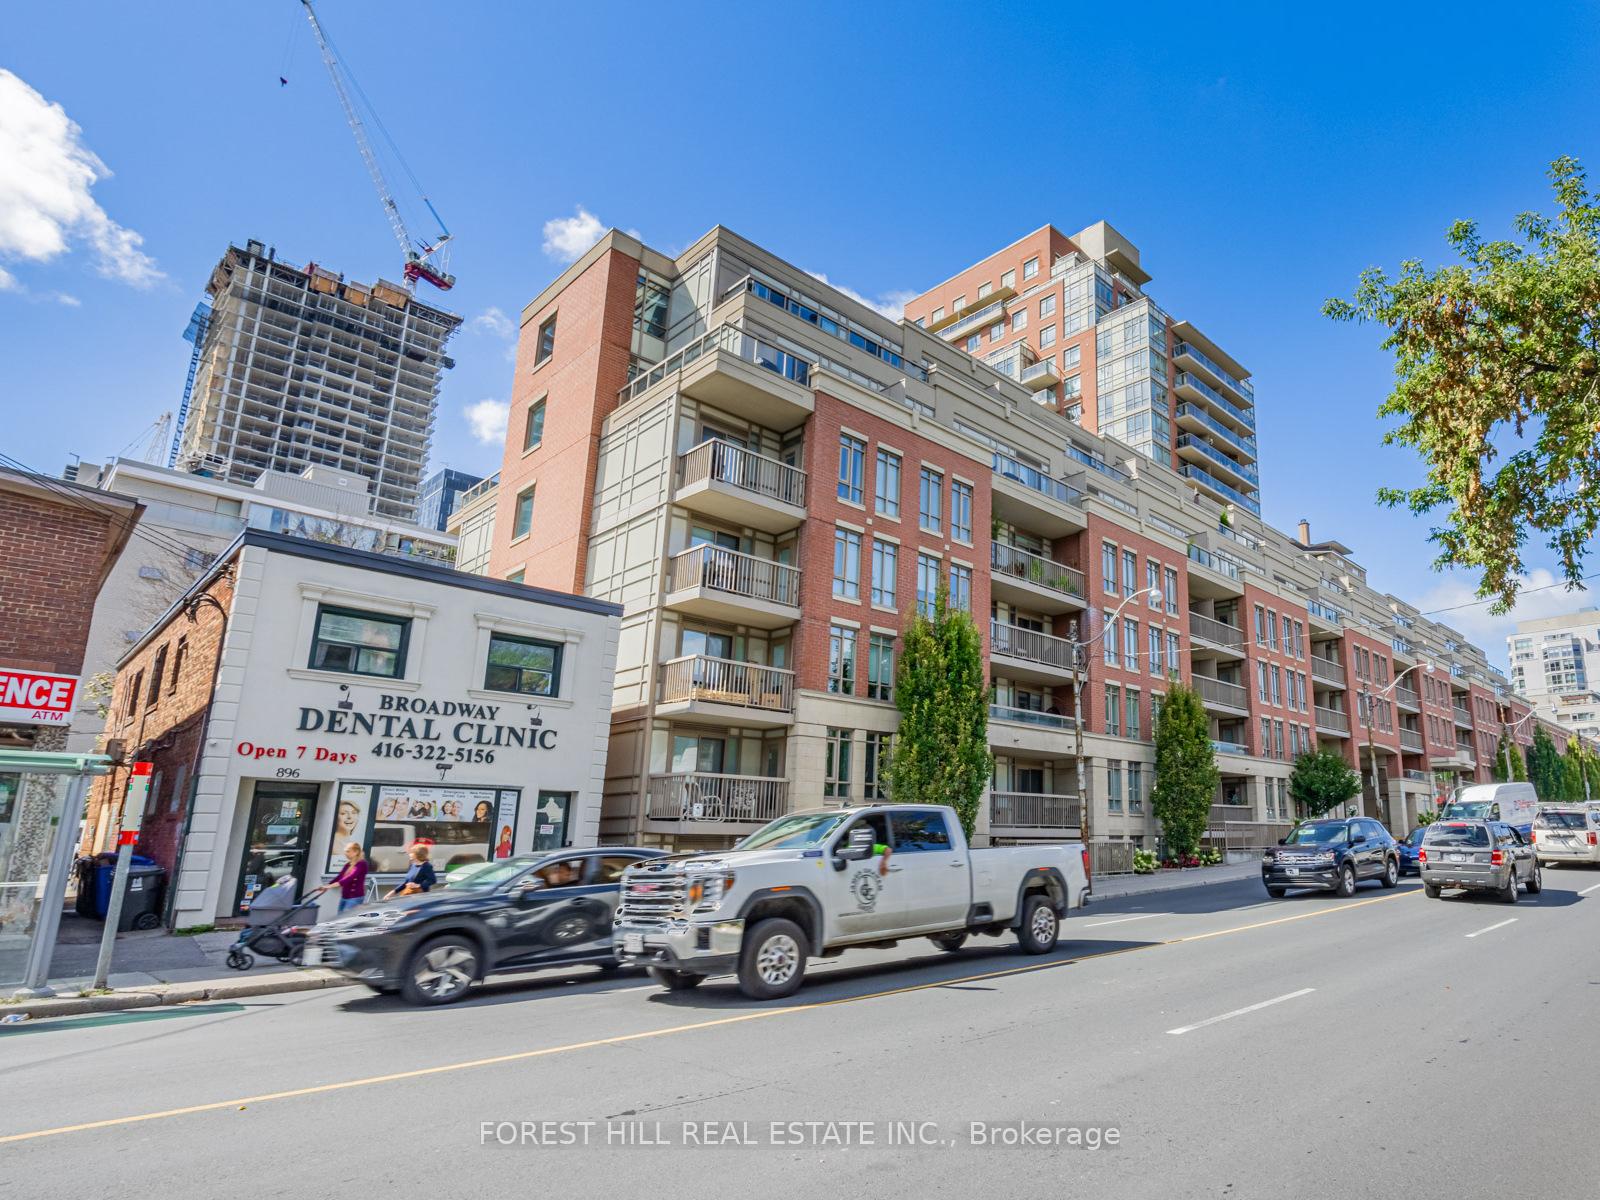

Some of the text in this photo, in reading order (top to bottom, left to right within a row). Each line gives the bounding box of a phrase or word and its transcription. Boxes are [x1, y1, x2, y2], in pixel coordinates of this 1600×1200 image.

[32, 710, 63, 721] ATM
[379, 694, 500, 721] BROADWAY
[296, 707, 557, 750] DENTAL CLINIC
[237, 741, 358, 764] Open 7 Days
[371, 741, 495, 764] 416-322-5156
[276, 767, 300, 779] 896
